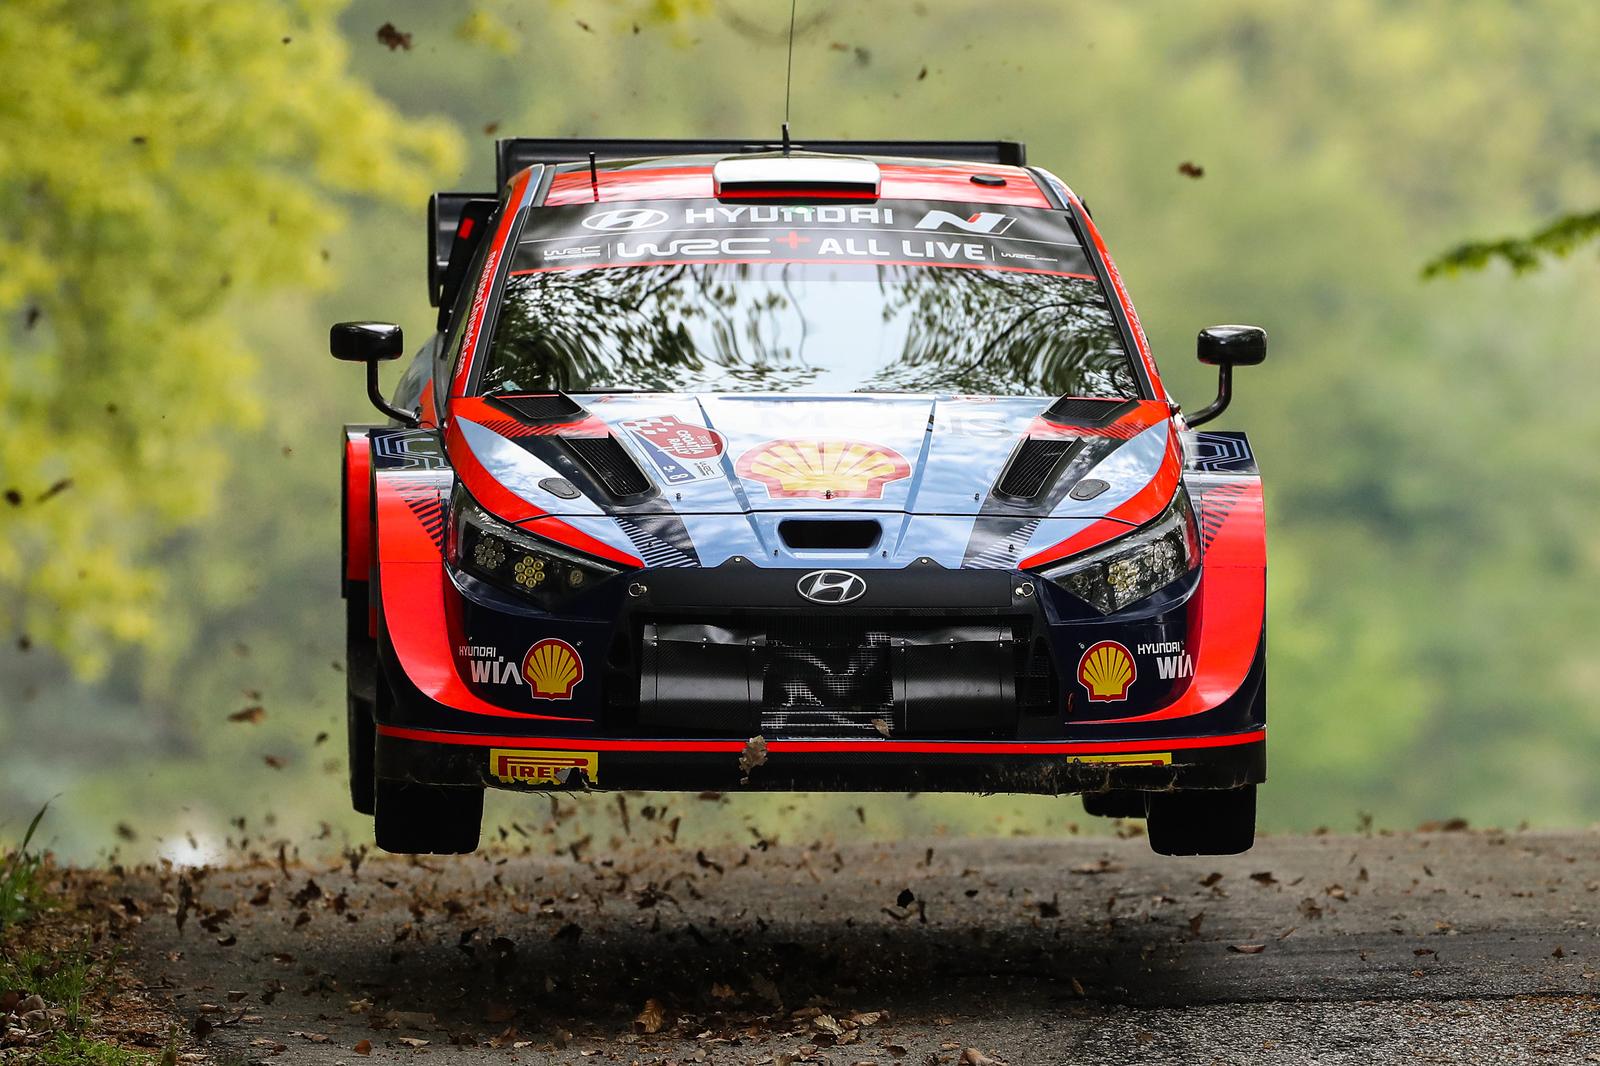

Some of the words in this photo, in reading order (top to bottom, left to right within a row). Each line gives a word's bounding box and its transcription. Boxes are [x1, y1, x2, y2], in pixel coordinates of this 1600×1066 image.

[685, 207, 893, 224] HYUNDAI
[817, 238, 890, 256] ALL
[902, 240, 987, 261] LIVE
[459, 645, 497, 658] HYUNDAI
[1137, 641, 1180, 654] HYUNDAI
[470, 660, 523, 684] WIA
[1156, 654, 1194, 680] WIA
[498, 756, 589, 777] PIRE
